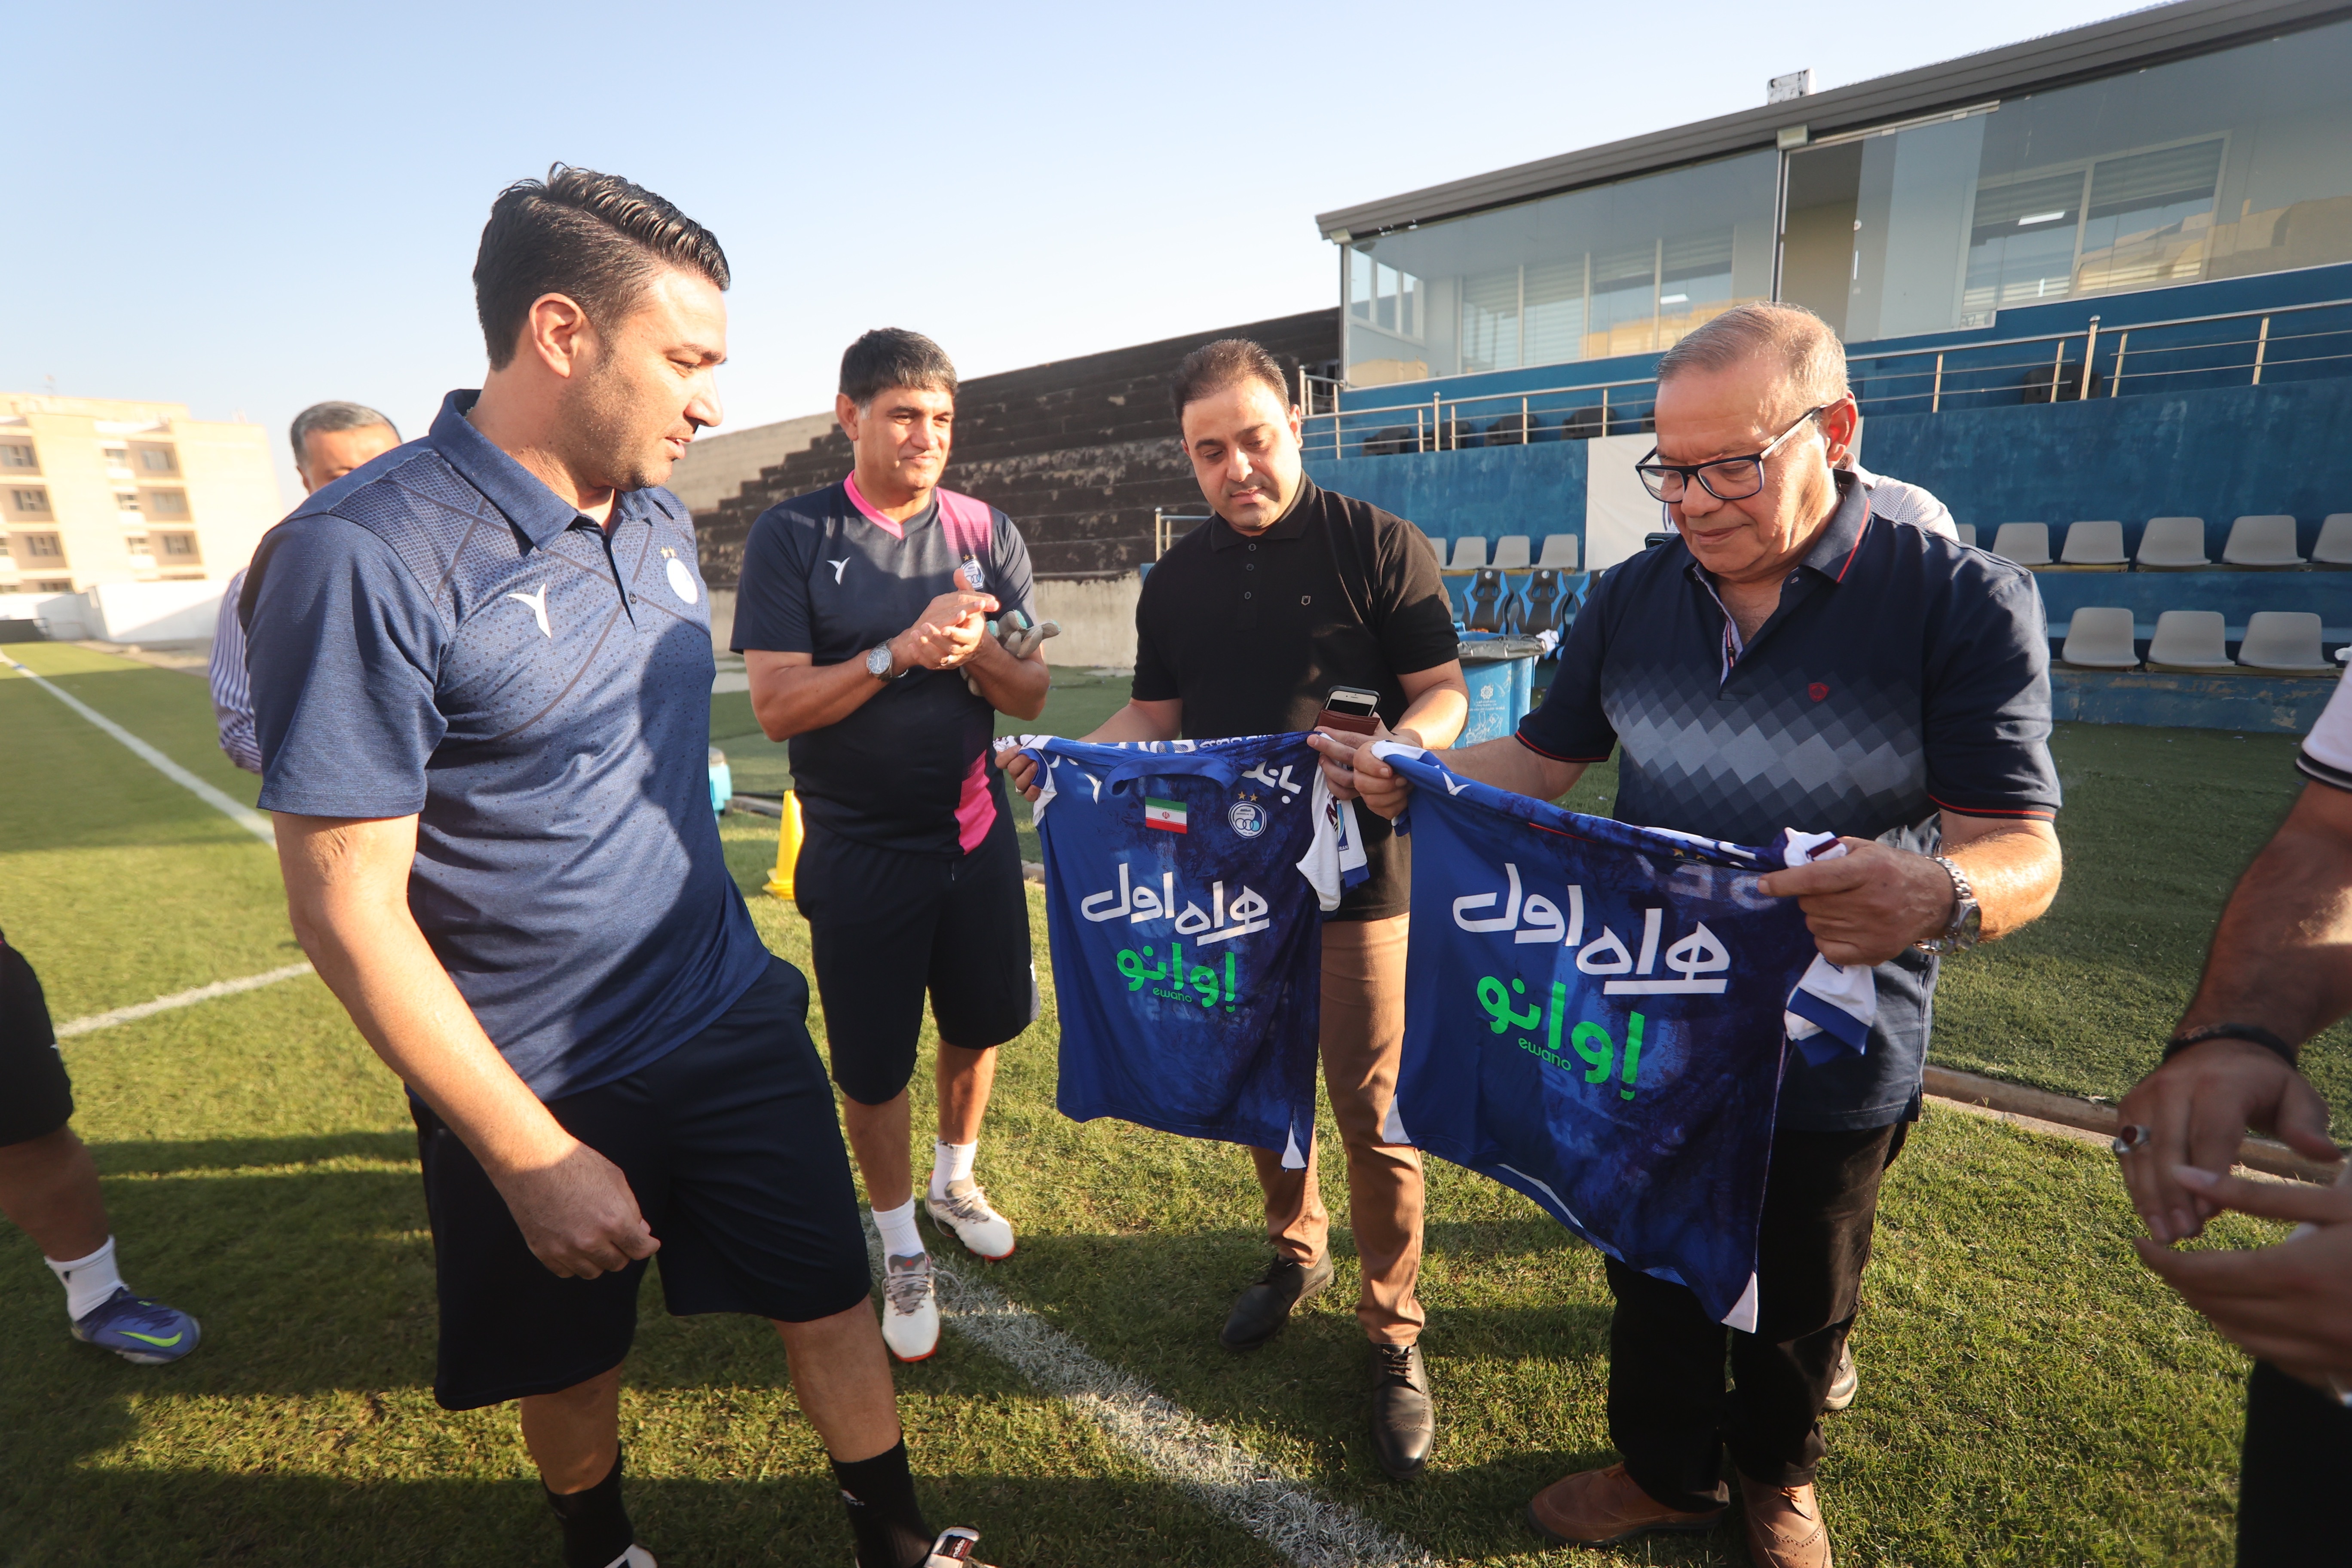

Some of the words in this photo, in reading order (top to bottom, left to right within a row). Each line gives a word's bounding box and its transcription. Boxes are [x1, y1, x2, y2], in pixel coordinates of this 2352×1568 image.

[1081, 863, 1175, 924] اول
[1452, 863, 1584, 946] اول
[1153, 987, 1192, 1002] ewano
[1518, 1038, 1572, 1071] ewano
